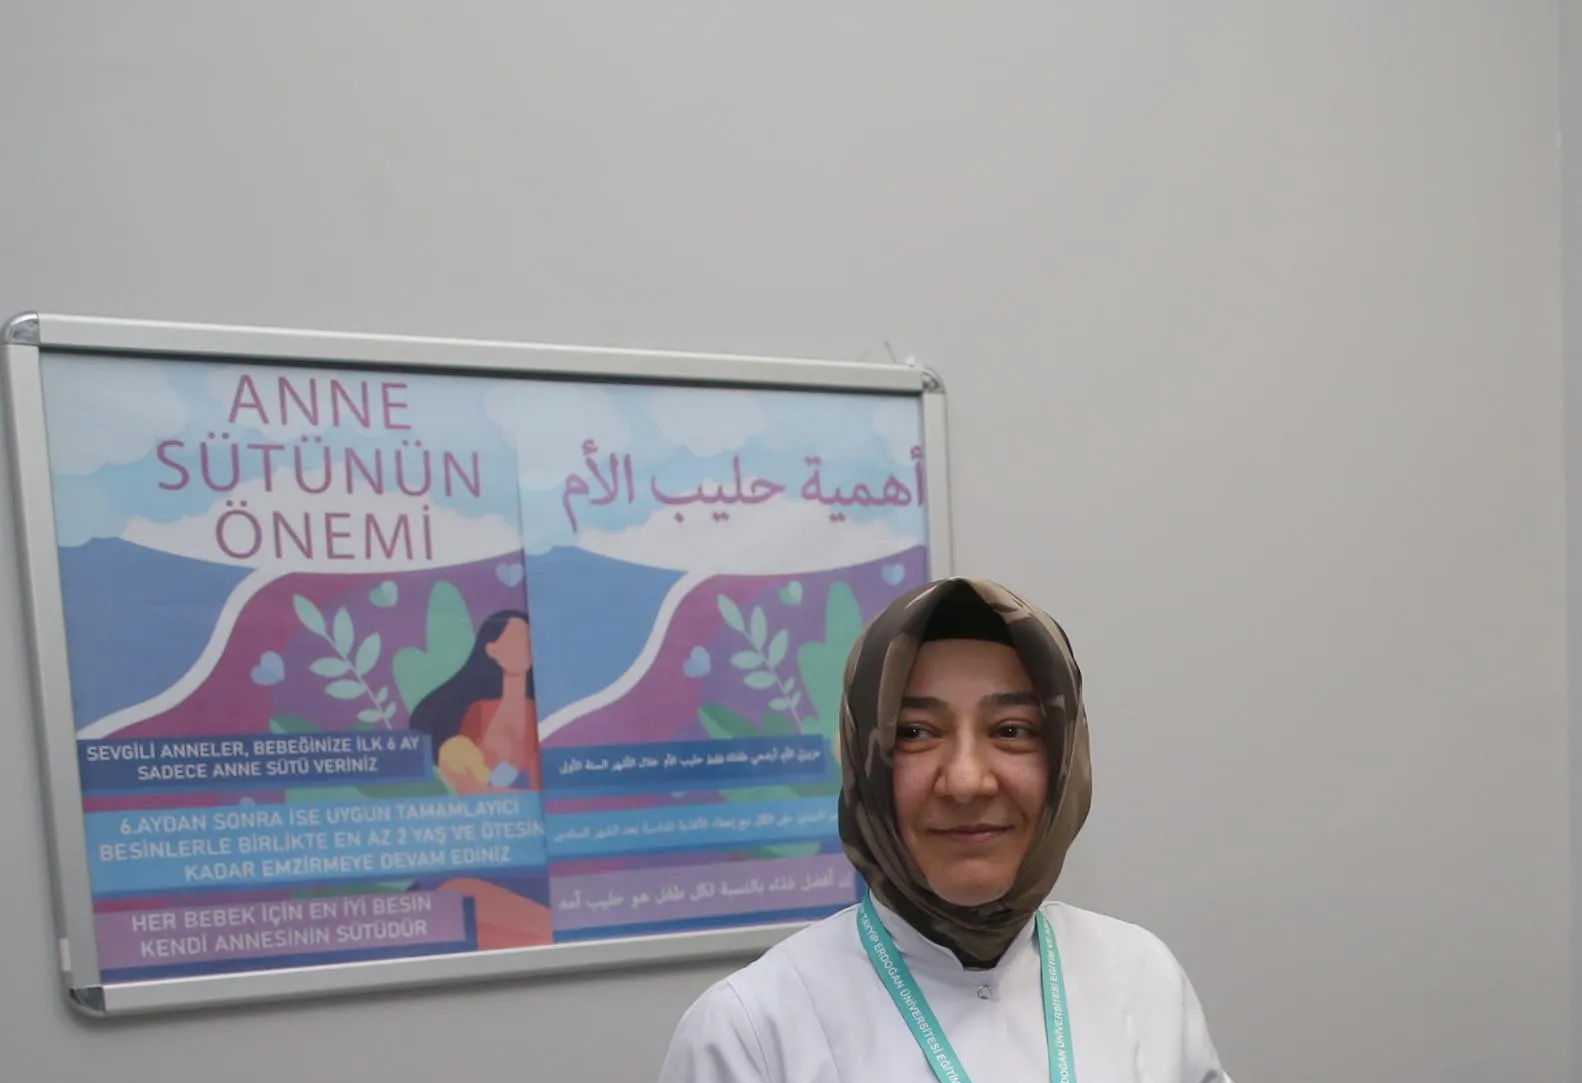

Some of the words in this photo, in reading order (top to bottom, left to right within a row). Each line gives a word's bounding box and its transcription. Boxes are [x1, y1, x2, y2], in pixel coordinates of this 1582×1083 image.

[228, 374, 412, 430] ANNE
[156, 432, 481, 498] SÜTÜNÜN
[801, 445, 924, 522] أهمية
[562, 438, 636, 534] الأم
[650, 456, 787, 523] حليب
[215, 499, 433, 561] ÖNEMİ
[87, 742, 155, 761] SEVGİLİ
[160, 741, 249, 759] ANNELER,
[253, 735, 352, 755] BEBEĞİNİZE
[356, 735, 382, 753] İLK
[387, 739, 396, 750] 6
[400, 736, 420, 750] AY
[138, 763, 207, 780] SADECE
[212, 760, 261, 777] ANNE
[266, 757, 310, 775] SÜTÜ
[313, 756, 379, 774] VERİNİZ
[120, 813, 206, 835] 6.AYDAN
[213, 812, 284, 830] SONRA
[326, 804, 392, 824] UYGUN
[397, 798, 520, 820] TAMAMLAYICI
[100, 836, 232, 861] BESİNLERLE
[238, 831, 328, 853] BİRLİKTE
[334, 831, 361, 848] EN
[368, 829, 391, 846] AZ
[397, 828, 407, 845] 2
[413, 826, 447, 845] YAŞ
[452, 824, 475, 841] VE
[184, 861, 255, 881] KADAR
[262, 854, 374, 877] EMZİRMEYE
[380, 850, 446, 869] DEVAM
[132, 911, 176, 932] HER
[184, 907, 255, 929] BEBEK
[261, 901, 304, 927] İÇİN
[309, 901, 337, 920] EN
[342, 898, 367, 917] İYİ
[372, 894, 432, 916] BESİN
[140, 937, 208, 958] KENDİ
[215, 926, 330, 952] ANNESİNİN
[336, 919, 428, 943] SÜTÜDÜR
